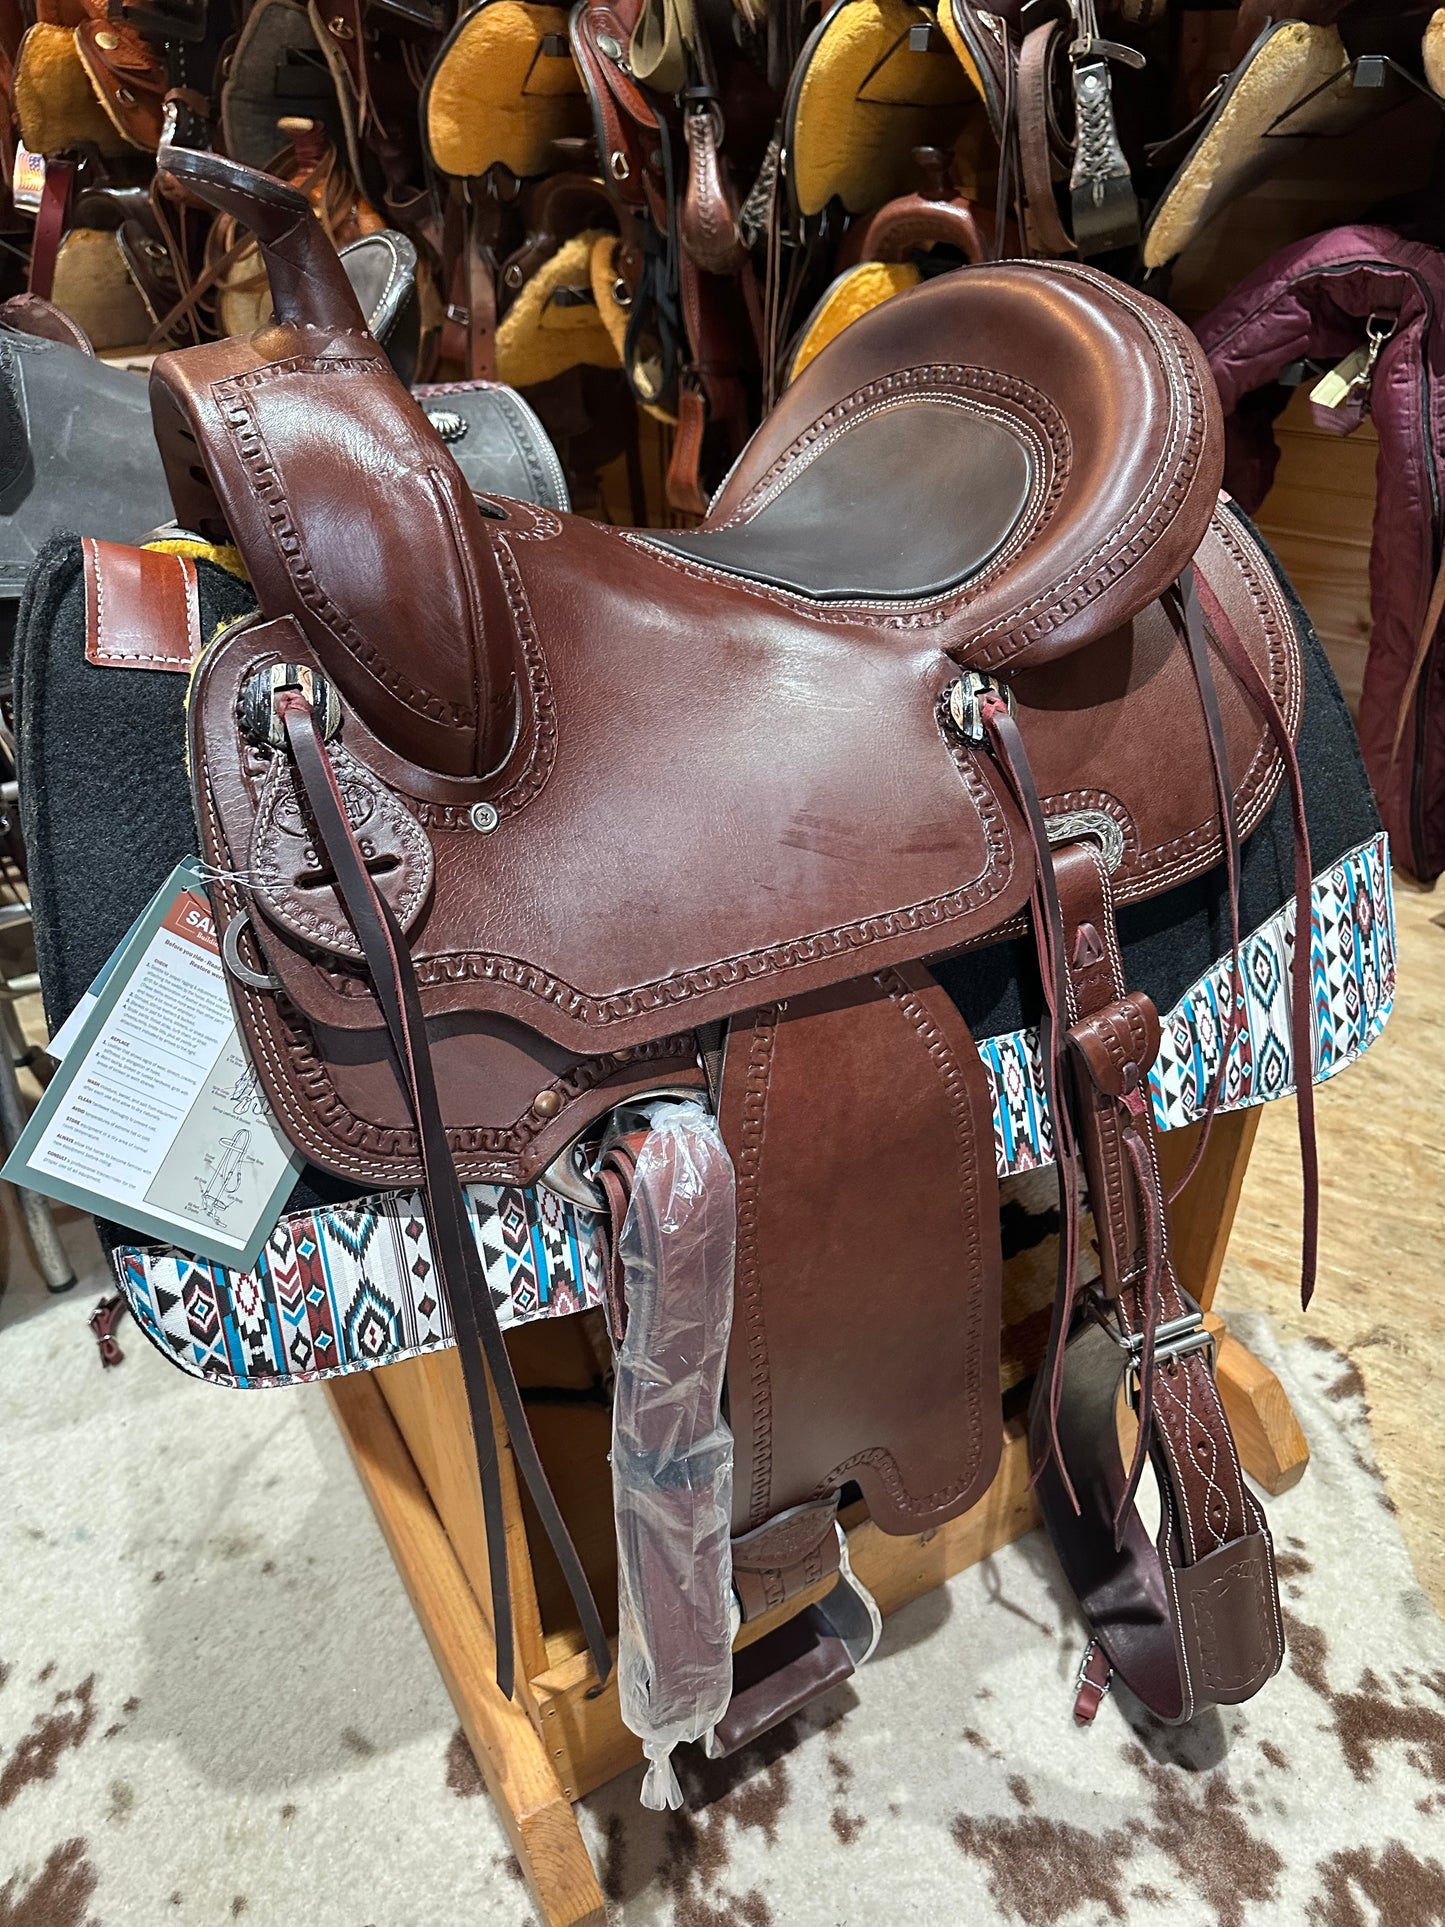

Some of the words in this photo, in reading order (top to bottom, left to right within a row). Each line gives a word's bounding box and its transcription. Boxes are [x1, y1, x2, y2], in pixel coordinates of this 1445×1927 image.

[164, 938, 182, 952] Before
[183, 946, 193, 958] you
[193, 953, 204, 963] ride
[207, 959, 221, 971] Read
[154, 958, 168, 968] CHECK
[189, 960, 210, 975] Restore
[110, 1036, 130, 1047] REPLACE
[87, 1078, 101, 1087] WASH
[77, 1095, 93, 1104] CLEAN
[71, 1105, 86, 1114] AVOID
[66, 1116, 81, 1125] STORE
[56, 1133, 75, 1143] ALWAYS
[47, 1150, 68, 1162] CONSULT
